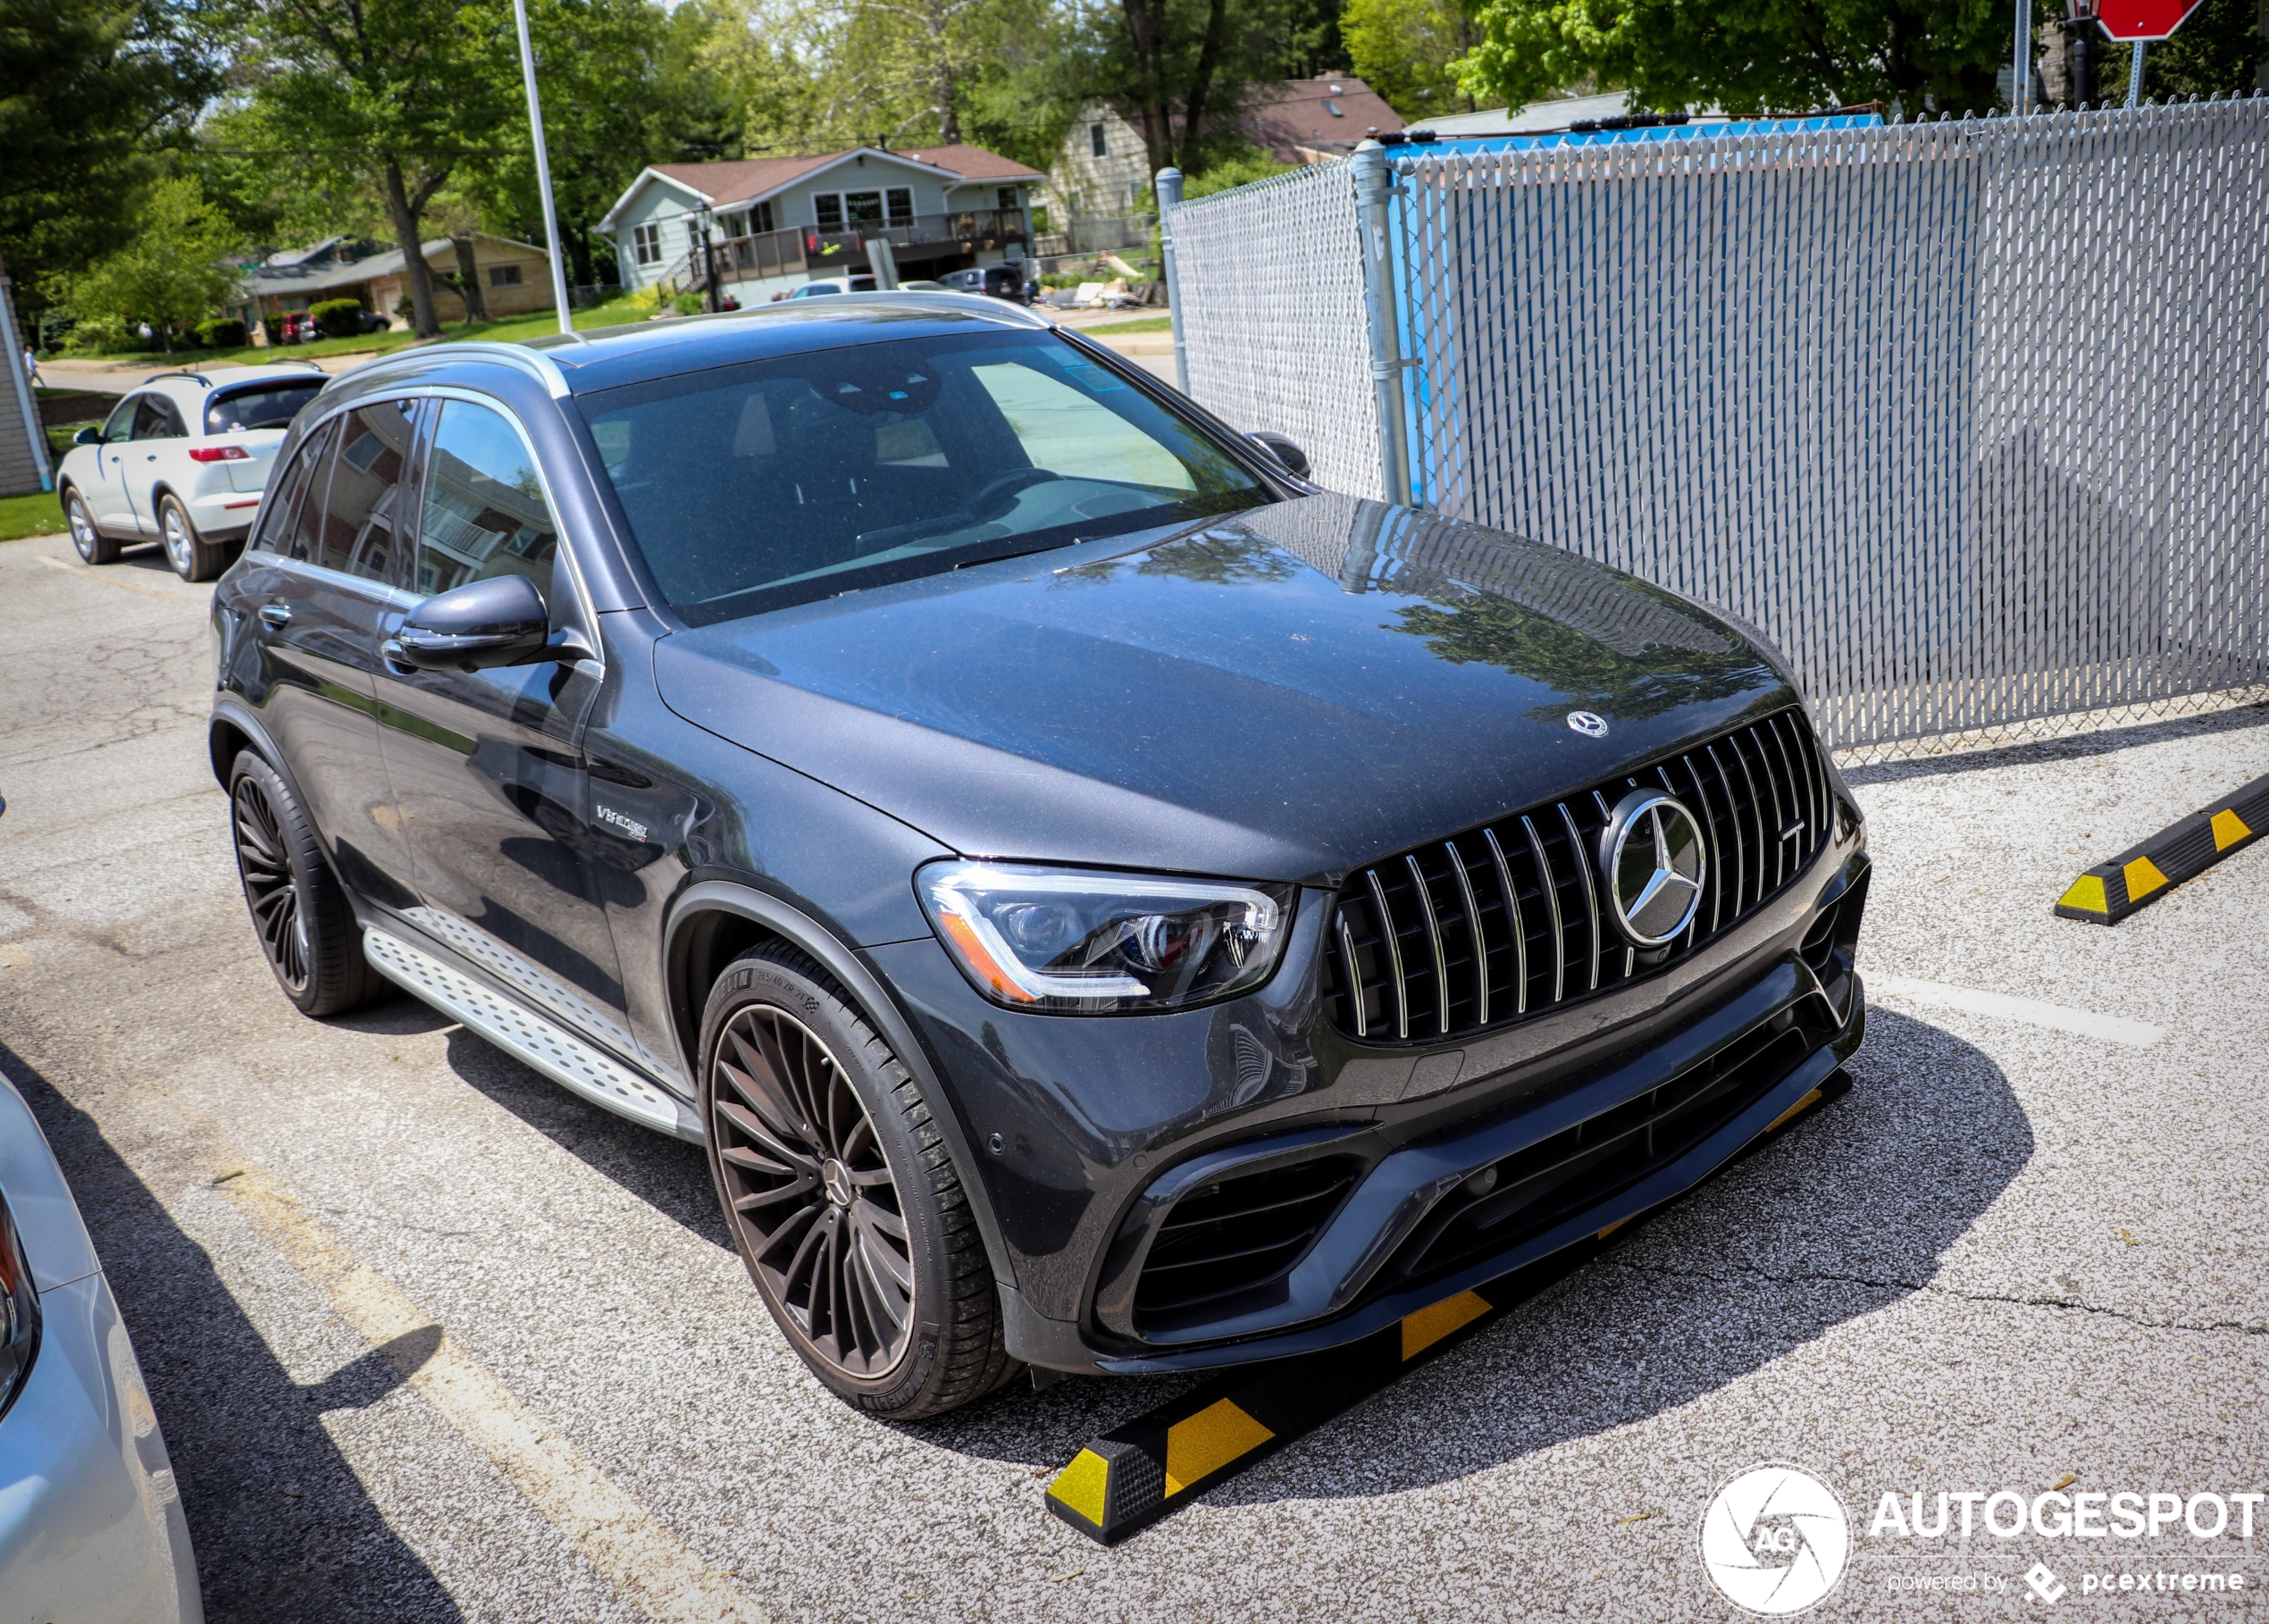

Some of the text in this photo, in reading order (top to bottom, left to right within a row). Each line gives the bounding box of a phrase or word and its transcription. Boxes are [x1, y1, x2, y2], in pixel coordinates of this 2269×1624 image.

[597, 805, 617, 824] V8
[758, 971, 783, 986] 265/40
[783, 981, 794, 994] ZR
